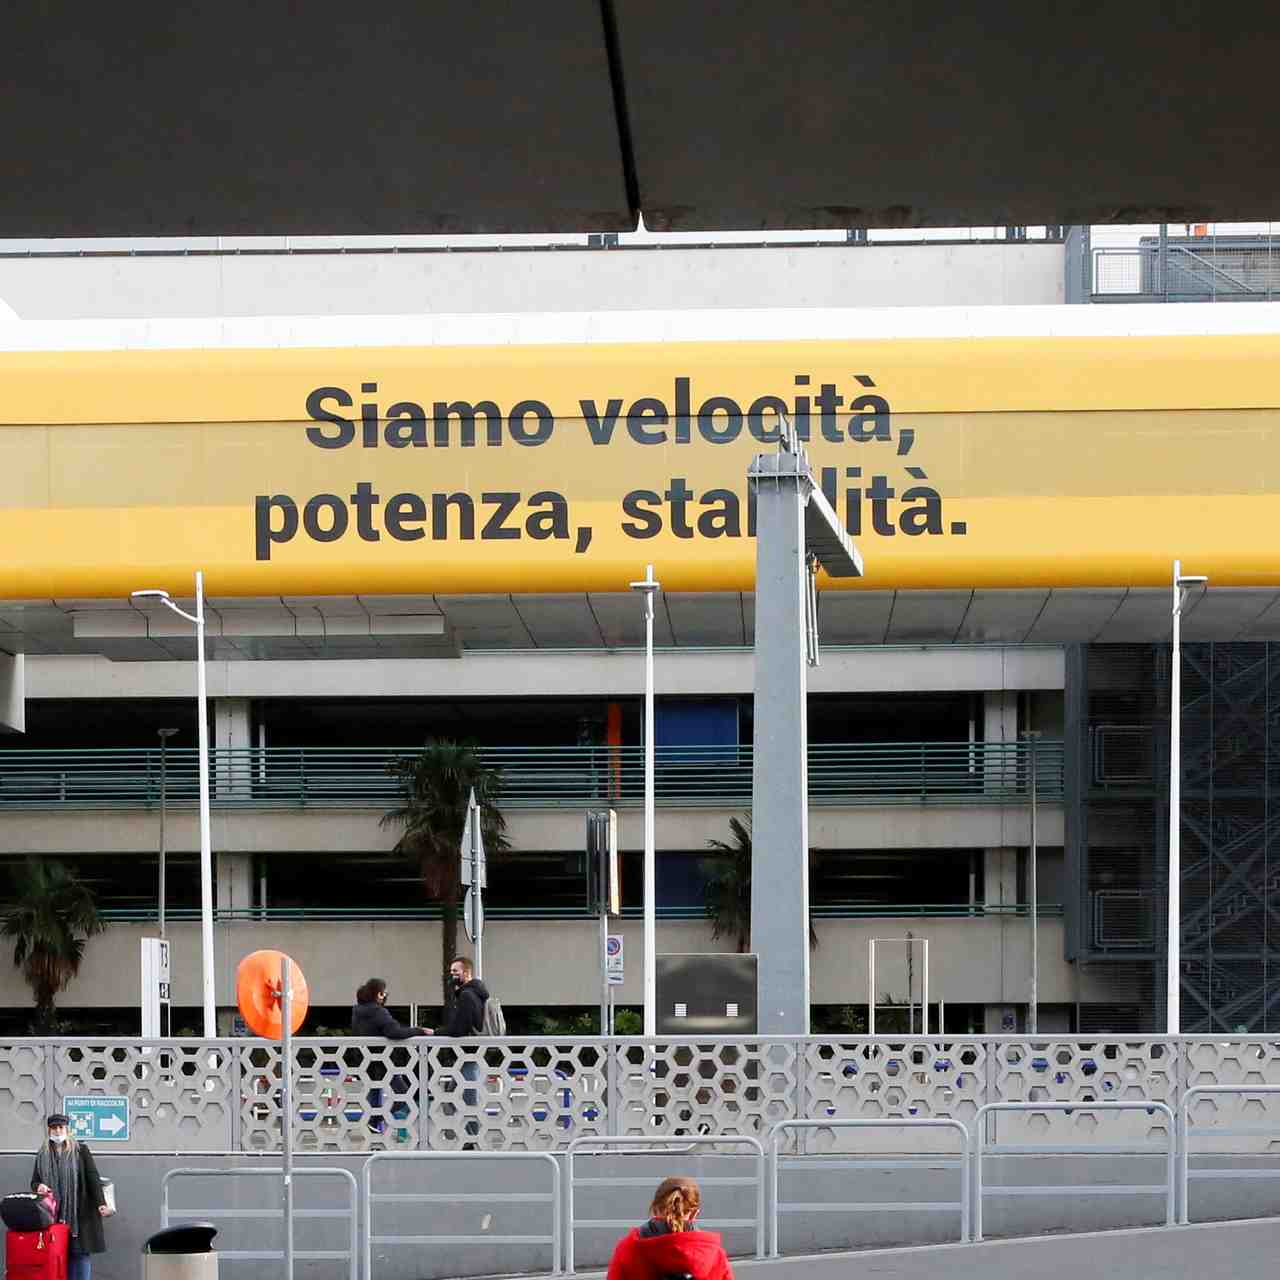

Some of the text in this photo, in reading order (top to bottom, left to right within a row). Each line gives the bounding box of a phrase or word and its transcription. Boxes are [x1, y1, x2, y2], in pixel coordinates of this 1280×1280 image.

[304, 375, 915, 456] Siamo velocità,
[255, 480, 594, 561] potenza,
